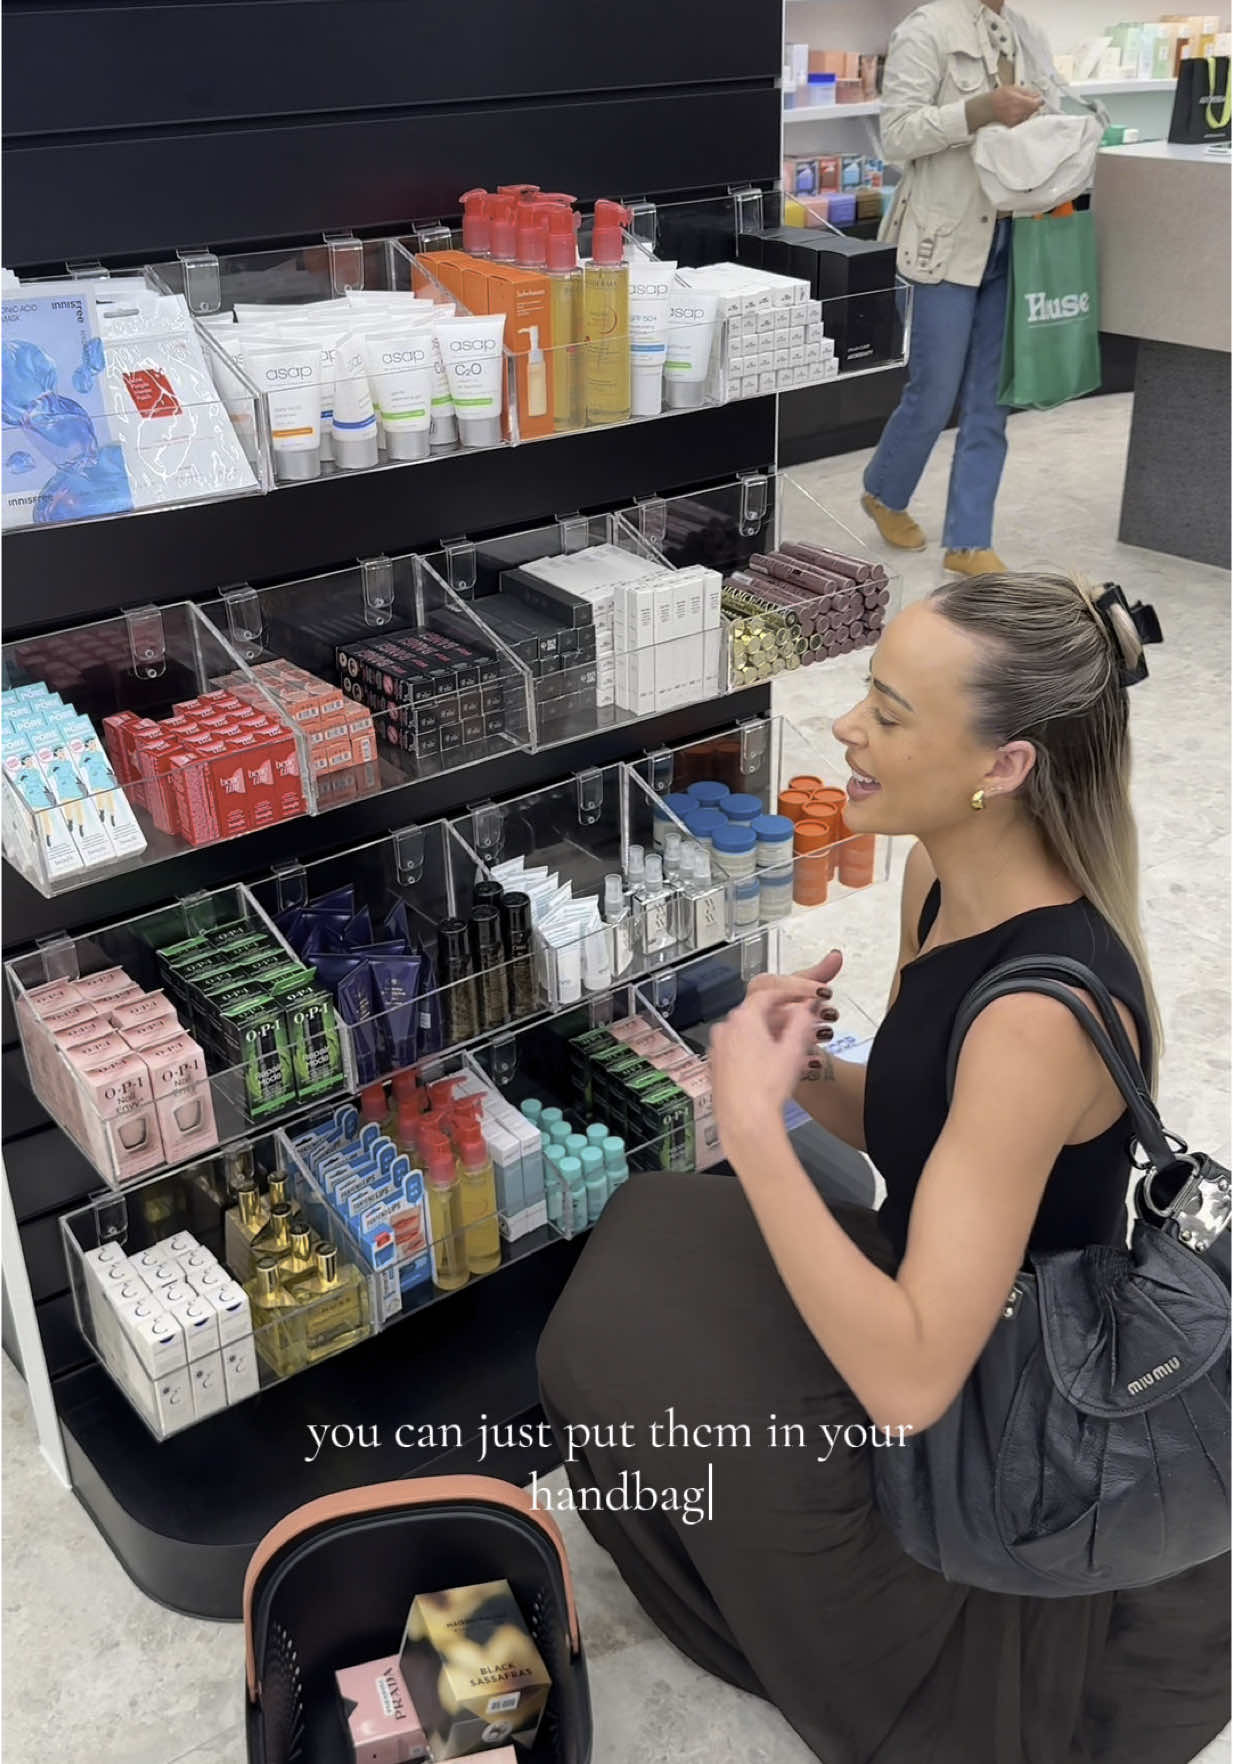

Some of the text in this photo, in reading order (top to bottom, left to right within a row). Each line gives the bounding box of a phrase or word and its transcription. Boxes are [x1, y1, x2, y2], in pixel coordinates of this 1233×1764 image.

[449, 338, 497, 352] asap
[382, 349, 425, 365] asap
[265, 366, 313, 381] asap
[479, 1662, 518, 1676] BLACK
[469, 1667, 533, 1688] SASSAFRAS
[383, 1666, 408, 1721] PRADA
